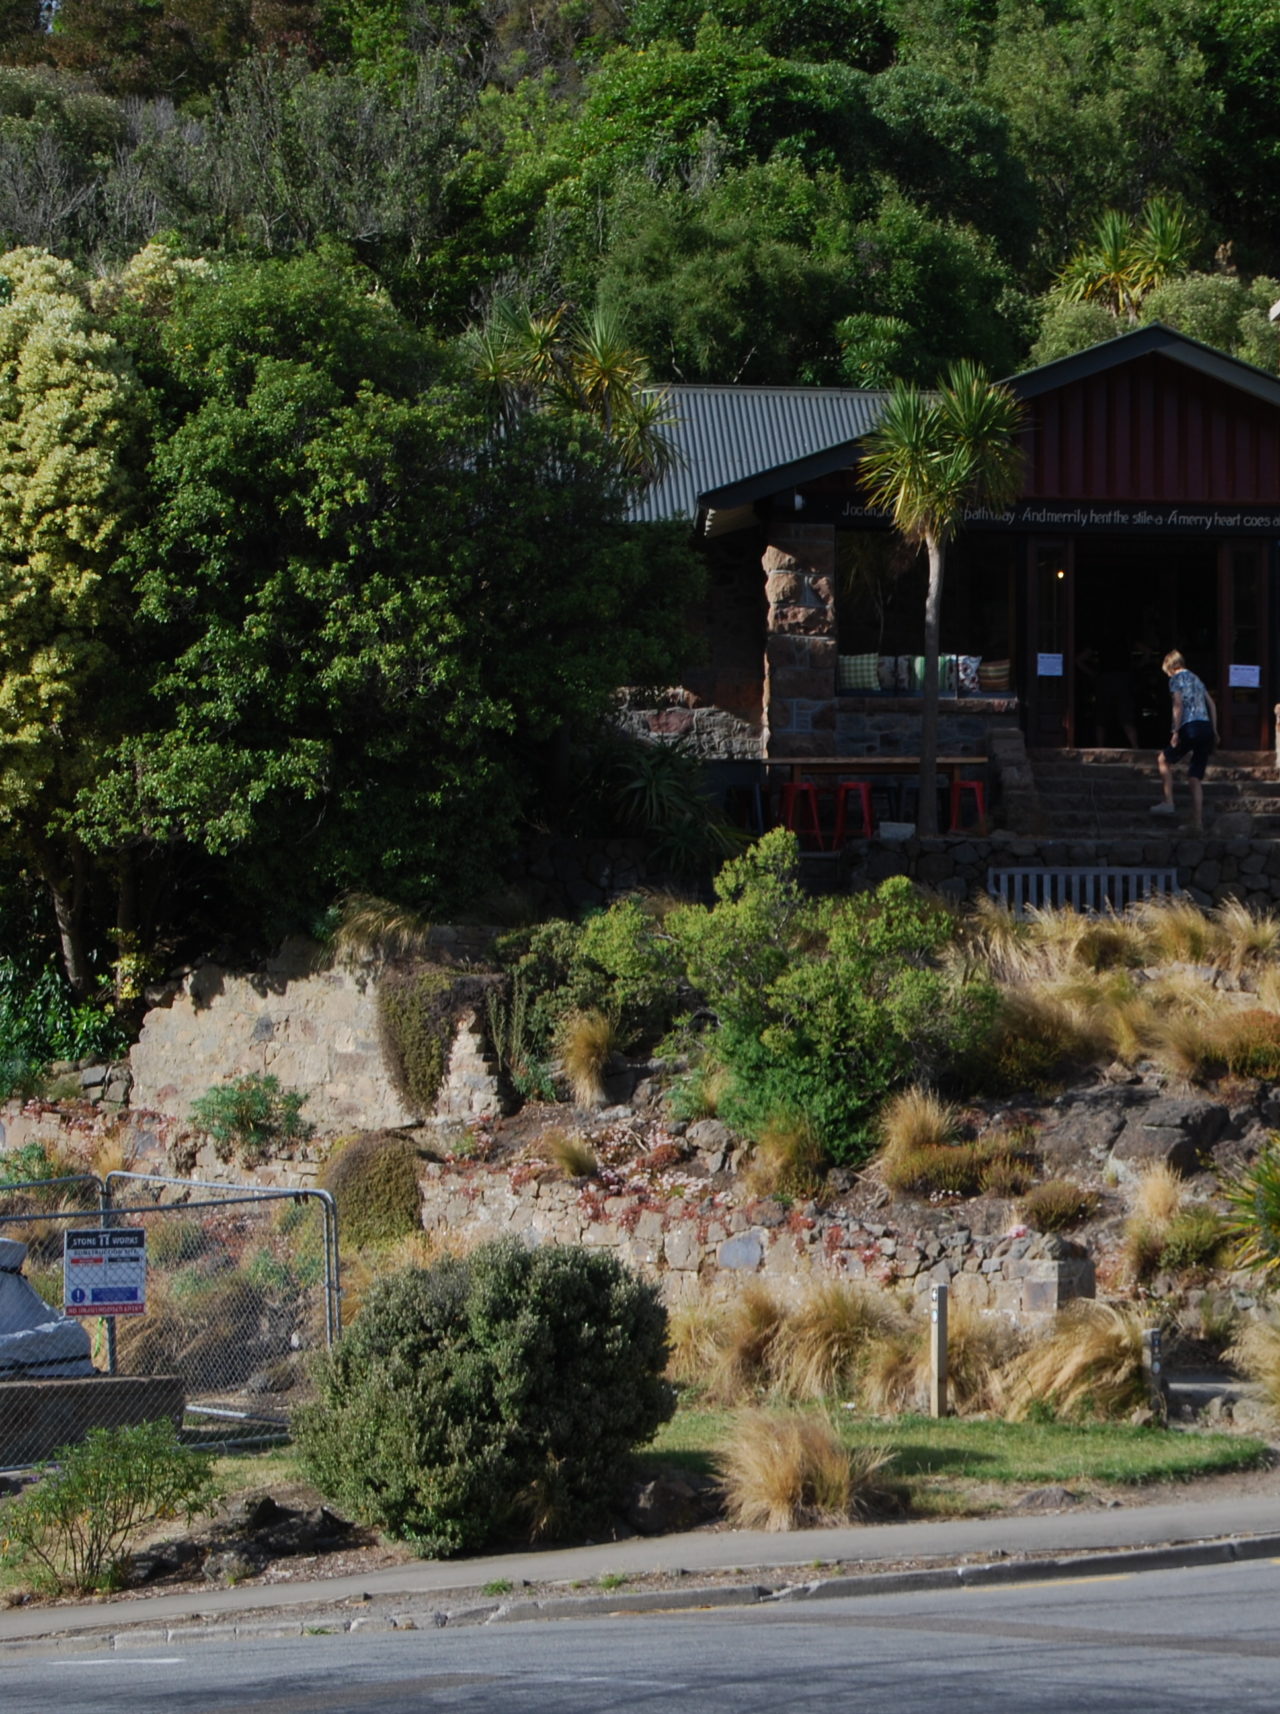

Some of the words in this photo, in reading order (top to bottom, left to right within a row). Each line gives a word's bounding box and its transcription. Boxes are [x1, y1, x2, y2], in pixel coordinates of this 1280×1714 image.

[1022, 507, 1046, 522] And
[1046, 509, 1087, 527] merrily
[1112, 510, 1129, 524] the
[1178, 513, 1213, 530] merry
[1213, 512, 1241, 526] heart
[73, 1237, 97, 1246] STONE
[112, 1236, 139, 1245] WORKS
